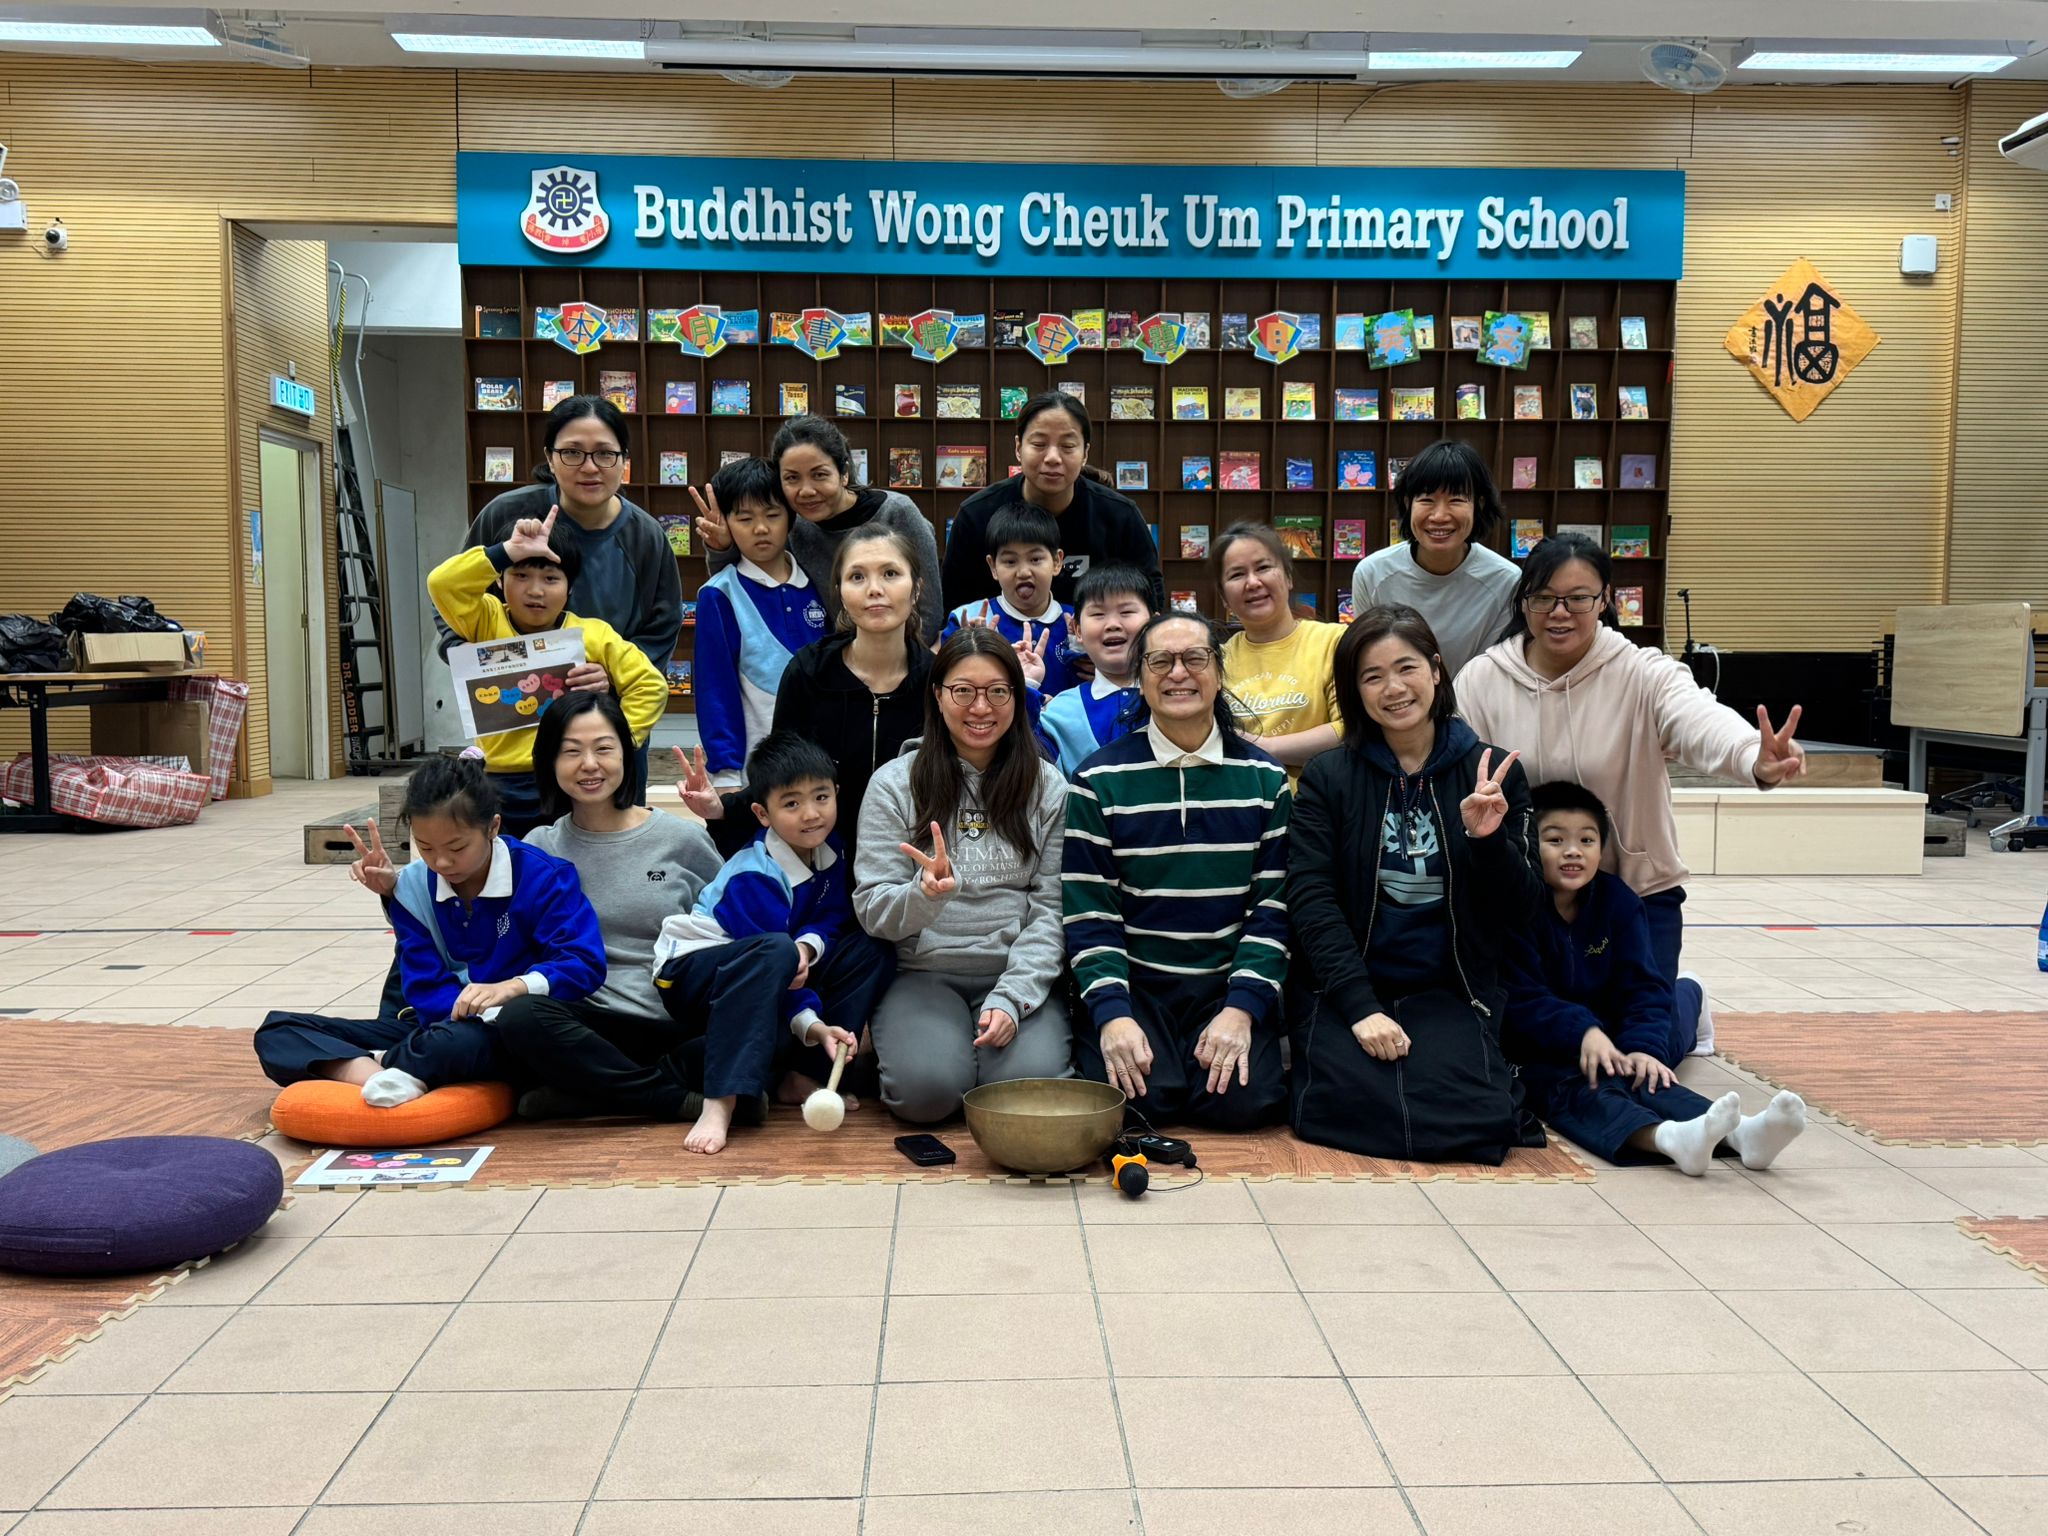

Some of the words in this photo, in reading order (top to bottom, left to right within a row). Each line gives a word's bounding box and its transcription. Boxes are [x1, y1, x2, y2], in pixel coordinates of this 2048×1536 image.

[633, 184, 853, 244] Buddhist
[869, 190, 1004, 257] Wong
[1018, 191, 1169, 250] Cheuk
[1184, 195, 1261, 250] Um
[1276, 195, 1463, 261] Primary
[1477, 197, 1629, 251] School
[566, 312, 595, 342] 本
[688, 315, 714, 347] 月
[807, 317, 834, 350] 書
[1037, 324, 1067, 357] 主
[1491, 326, 1523, 353] 文
[280, 380, 297, 407] EXIT
[342, 662, 359, 734] DR.LADDER
[1223, 689, 1309, 714] California
[972, 864, 988, 872] OF
